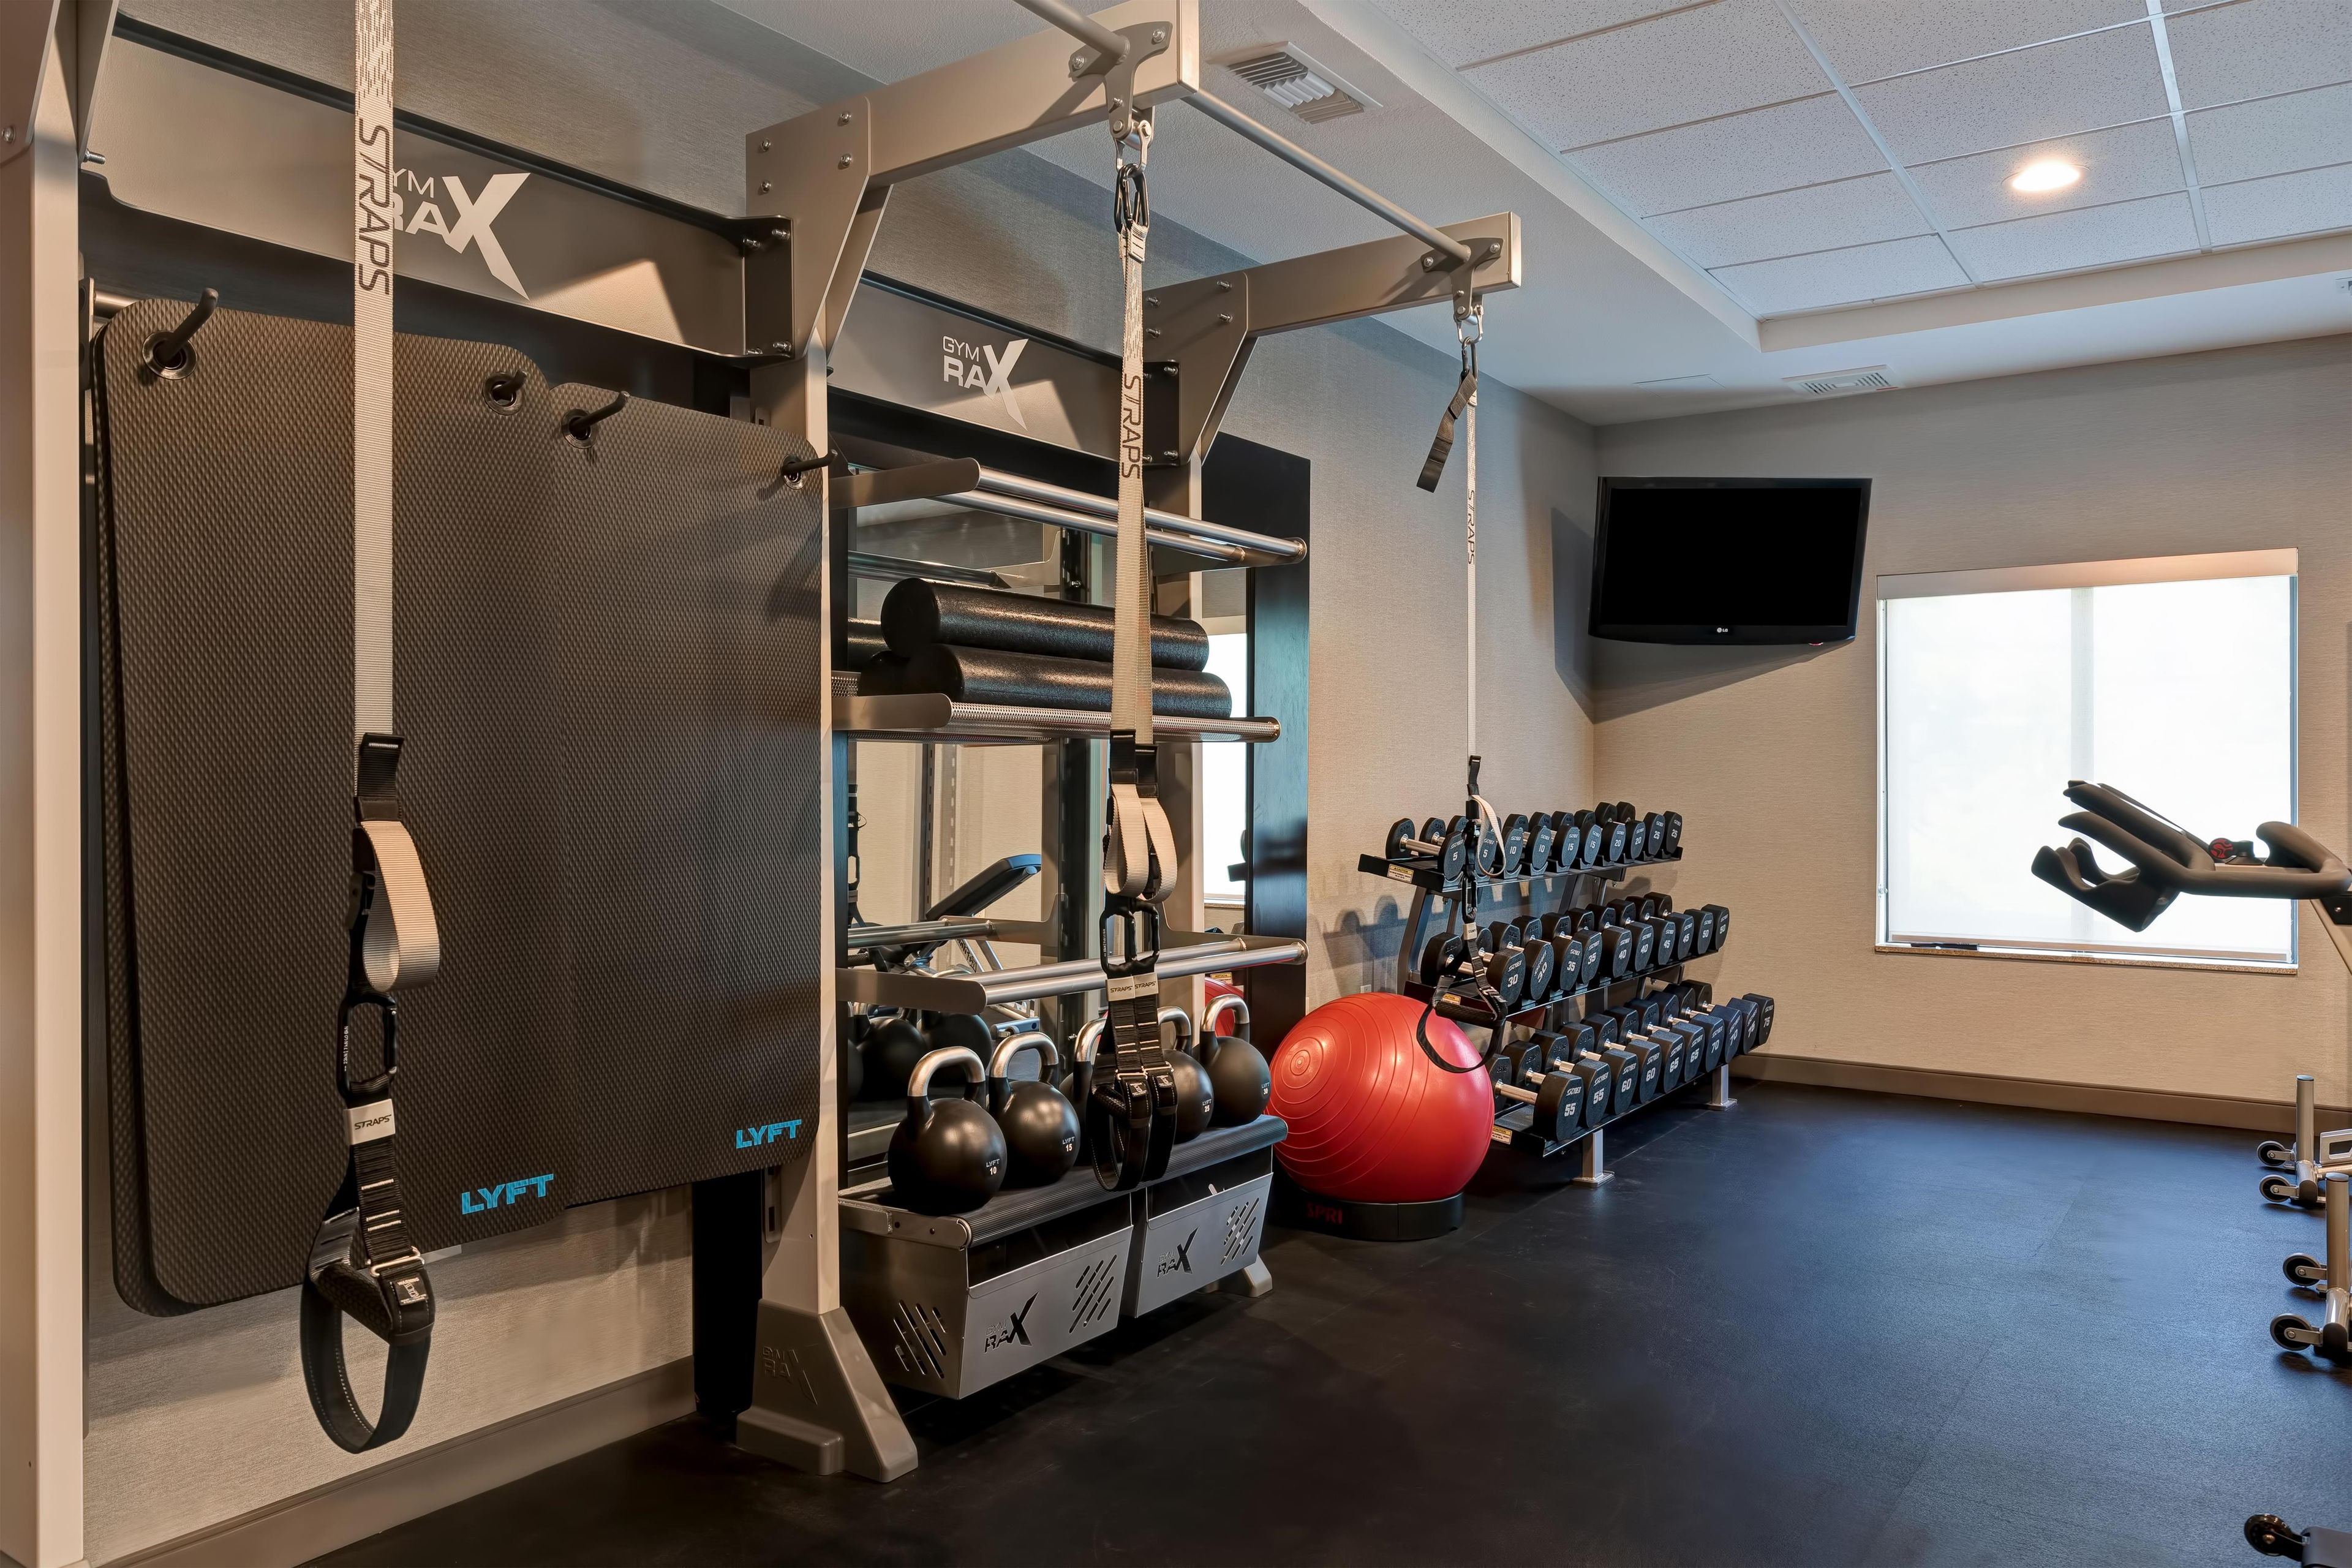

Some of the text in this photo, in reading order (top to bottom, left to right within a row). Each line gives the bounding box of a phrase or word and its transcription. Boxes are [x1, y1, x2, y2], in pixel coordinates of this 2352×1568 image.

[393, 168, 434, 198] YM
[358, 118, 390, 295] STRAPS
[942, 336, 979, 362] GYM
[943, 338, 1029, 431] RAX
[1121, 372, 1142, 480] STRAPS
[1635, 837, 1642, 845] 20
[1654, 831, 1660, 840] 25
[1671, 829, 1678, 839] 25
[1510, 846, 1517, 854] 10
[1539, 844, 1545, 853] 10
[1590, 840, 1596, 849] 15
[1452, 851, 1458, 861] 5
[1483, 850, 1488, 858] 5
[1702, 929, 1709, 938] 50
[1719, 924, 1726, 934] 50
[1664, 940, 1671, 949] 45
[1683, 933, 1690, 943] 45
[1618, 949, 1627, 960] 40
[1640, 943, 1649, 954] 40
[1588, 952, 1597, 965] 35
[1537, 962, 1548, 982] 30
[1567, 961, 1576, 971] 35
[1134, 981, 1156, 989] STRAPS
[1507, 974, 1518, 988] 30
[1747, 1020, 1755, 1038] 75
[1763, 1017, 1771, 1028] 75
[1730, 1028, 1738, 1046] 70
[1711, 1039, 1719, 1054] 70
[1690, 1048, 1700, 1063] 65
[1669, 1057, 1679, 1072] 65
[1646, 1067, 1656, 1082] 60
[1621, 1078, 1632, 1093] 60
[1593, 1088, 1605, 1104] 55
[1564, 1102, 1576, 1117] 55
[355, 1114, 392, 1130] STRAPS
[736, 1119, 802, 1150] LYFT
[986, 1158, 1000, 1167] LYFT
[990, 1166, 997, 1175] 10
[461, 1174, 554, 1215] LYFT
[1306, 1202, 1343, 1224] SPRI
[1156, 1225, 1200, 1278] RAX
[984, 1291, 1039, 1354] RAX
